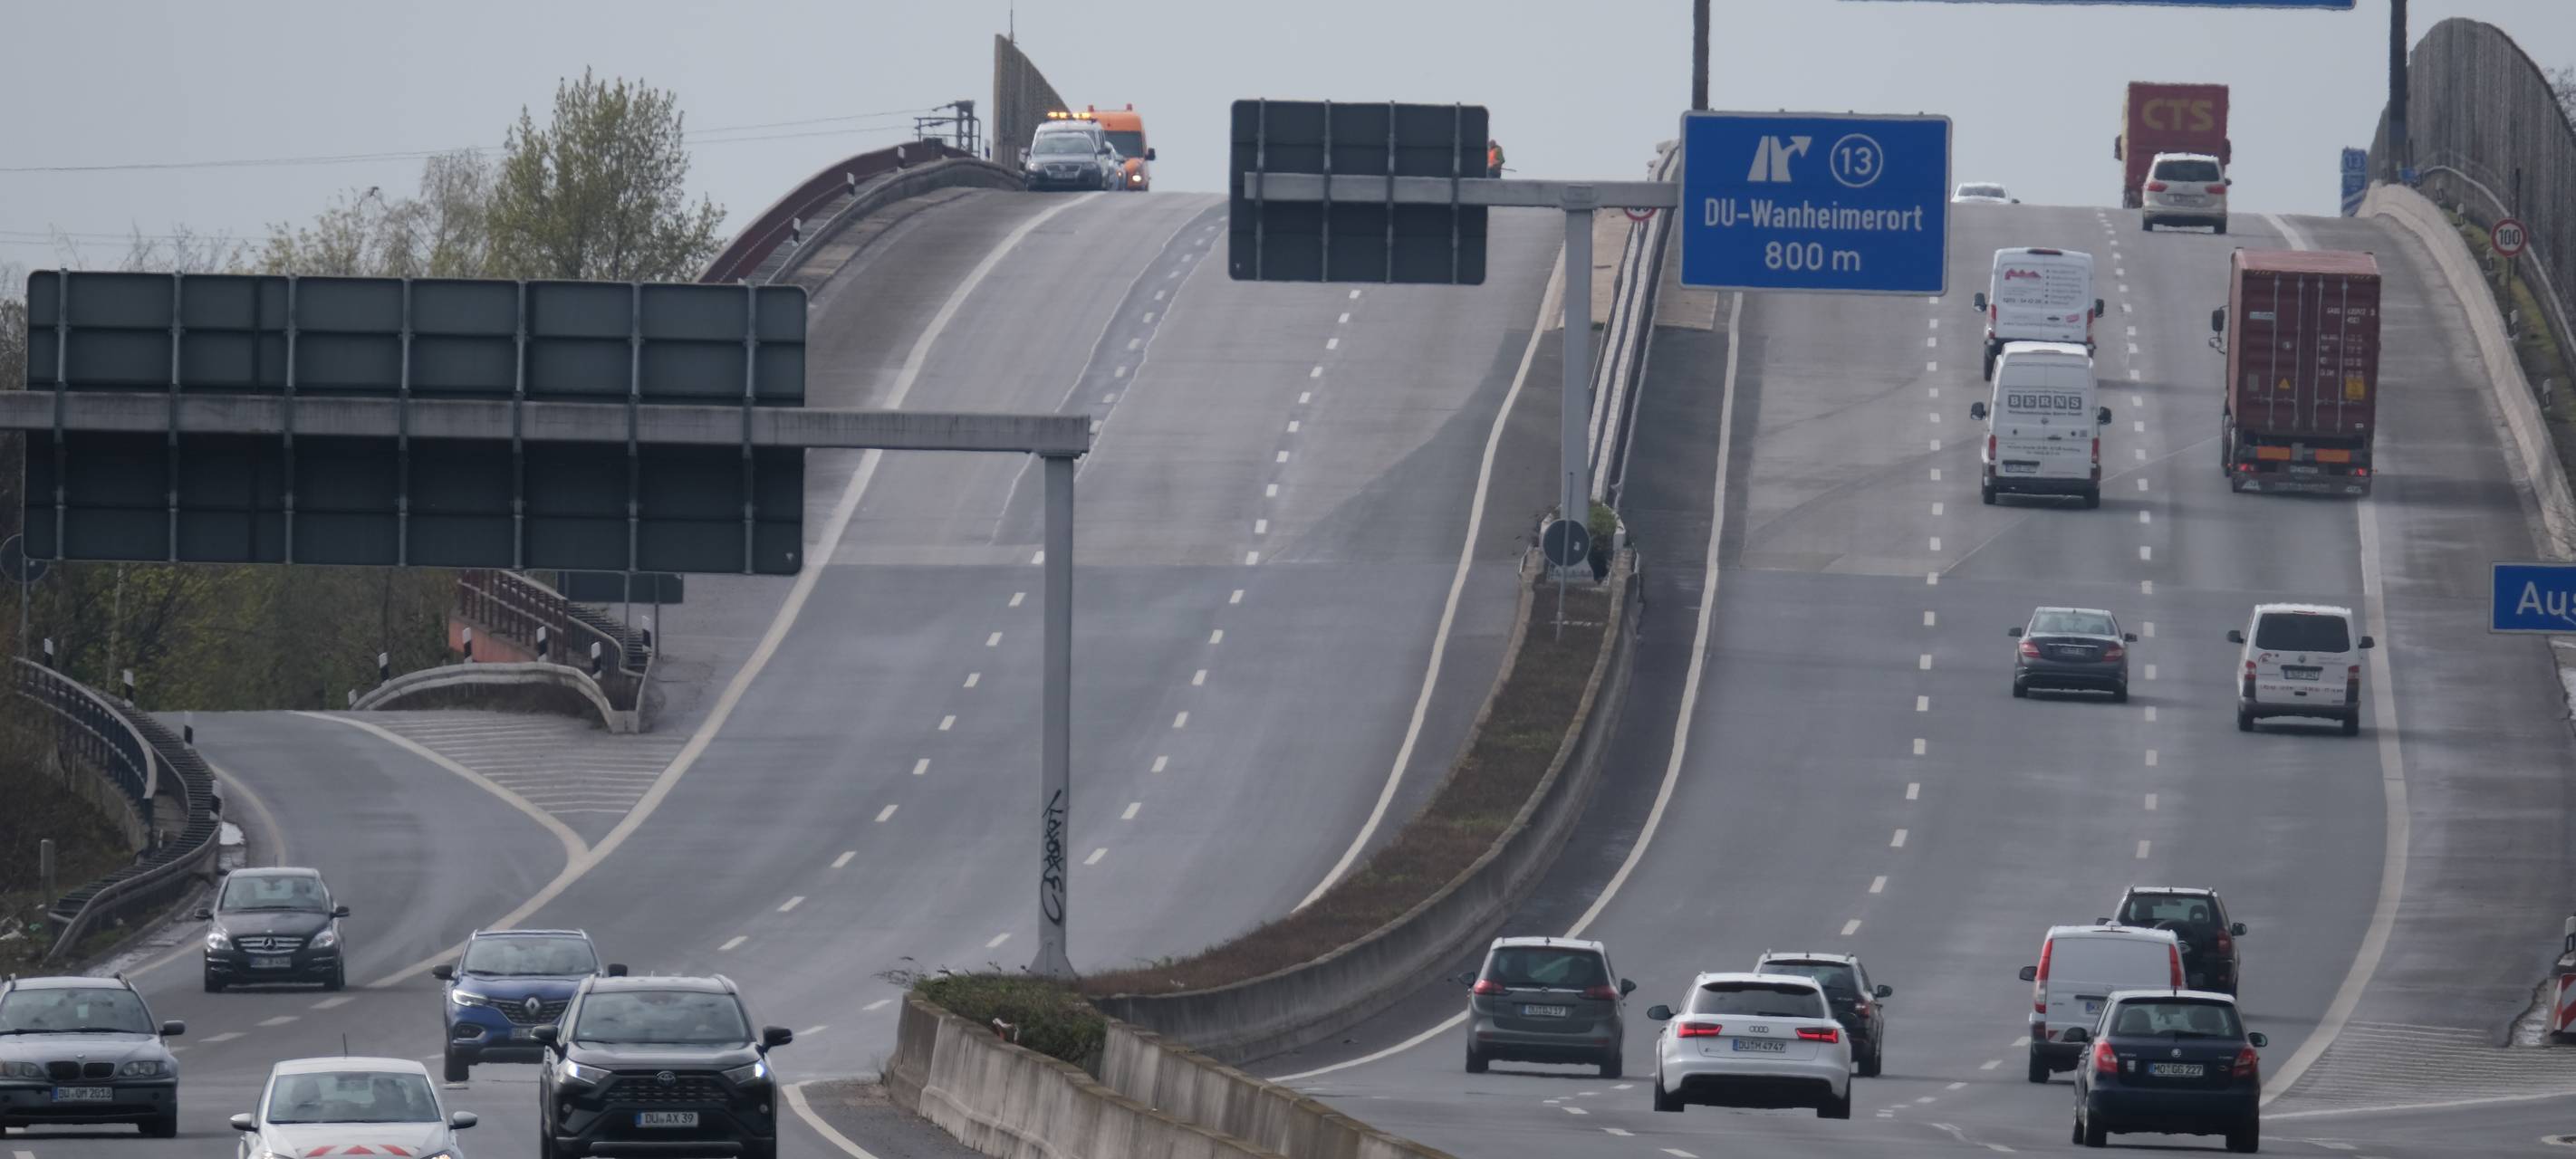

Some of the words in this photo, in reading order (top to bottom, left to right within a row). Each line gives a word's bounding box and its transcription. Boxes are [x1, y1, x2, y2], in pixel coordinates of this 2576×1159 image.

[2142, 98, 2214, 131] CTS
[1840, 147, 1872, 176] 13
[1705, 197, 1923, 232] DU-Wanheimerort
[2498, 229, 2521, 245] 100
[1764, 241, 1823, 271] 800
[1831, 249, 1861, 272] m
[2009, 395, 2081, 409] BERNS
[2185, 1065, 2203, 1076] 227
[644, 1113, 658, 1124] DU
[666, 1113, 680, 1124] AX
[681, 1113, 695, 1124] 39
